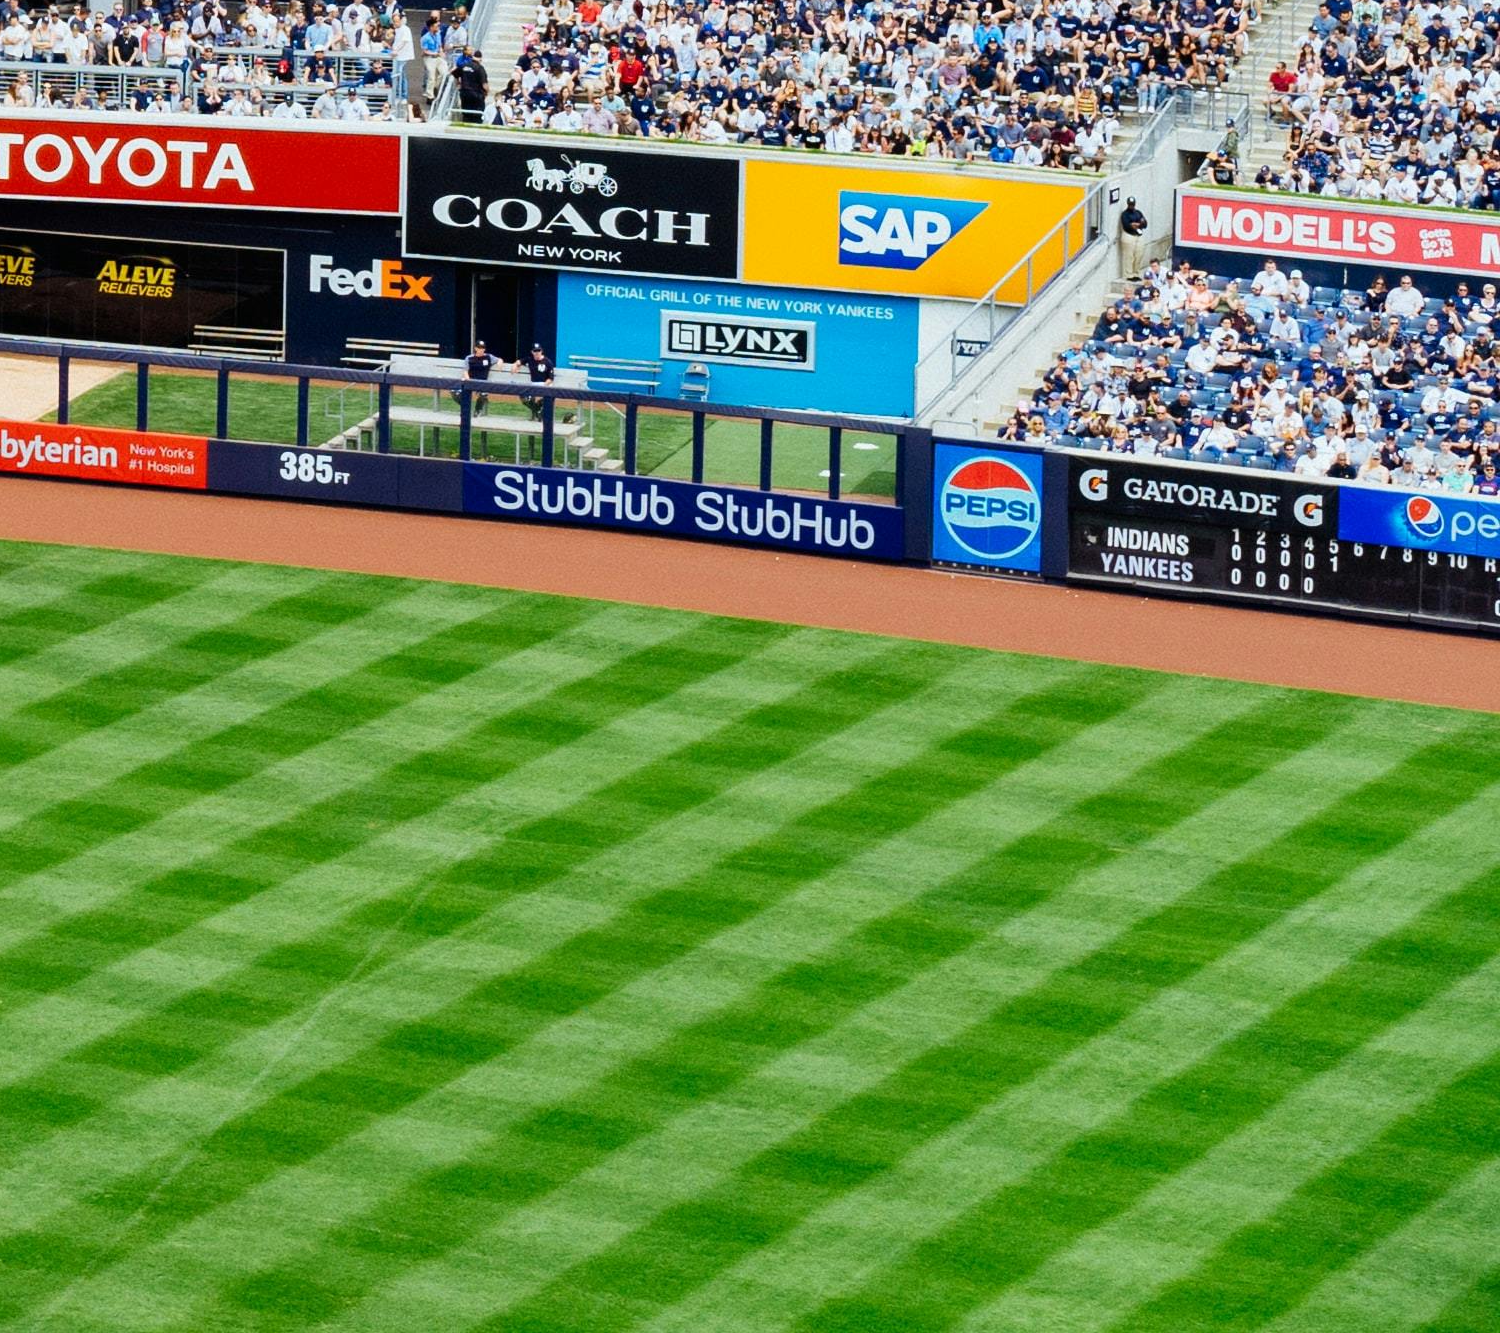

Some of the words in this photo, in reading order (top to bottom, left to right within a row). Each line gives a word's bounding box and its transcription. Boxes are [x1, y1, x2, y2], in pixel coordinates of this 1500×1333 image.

[432, 194, 710, 247] COACH
[840, 204, 952, 257] SAP
[517, 243, 562, 261] NEW
[569, 247, 622, 264] YORK
[310, 253, 434, 302] FedEx
[586, 283, 638, 300] OFFICIAL
[645, 288, 688, 304] GRILL
[692, 292, 712, 306] OF
[718, 295, 743, 309] THE
[747, 298, 776, 312] NEW
[781, 300, 821, 316] YORK
[827, 303, 894, 320] YANKEES
[705, 324, 800, 356] LYNX
[494, 469, 674, 526] StubHub
[696, 491, 874, 551] StubHub
[946, 493, 1036, 523] PEPSI
[1124, 479, 1278, 516] GATORADE
